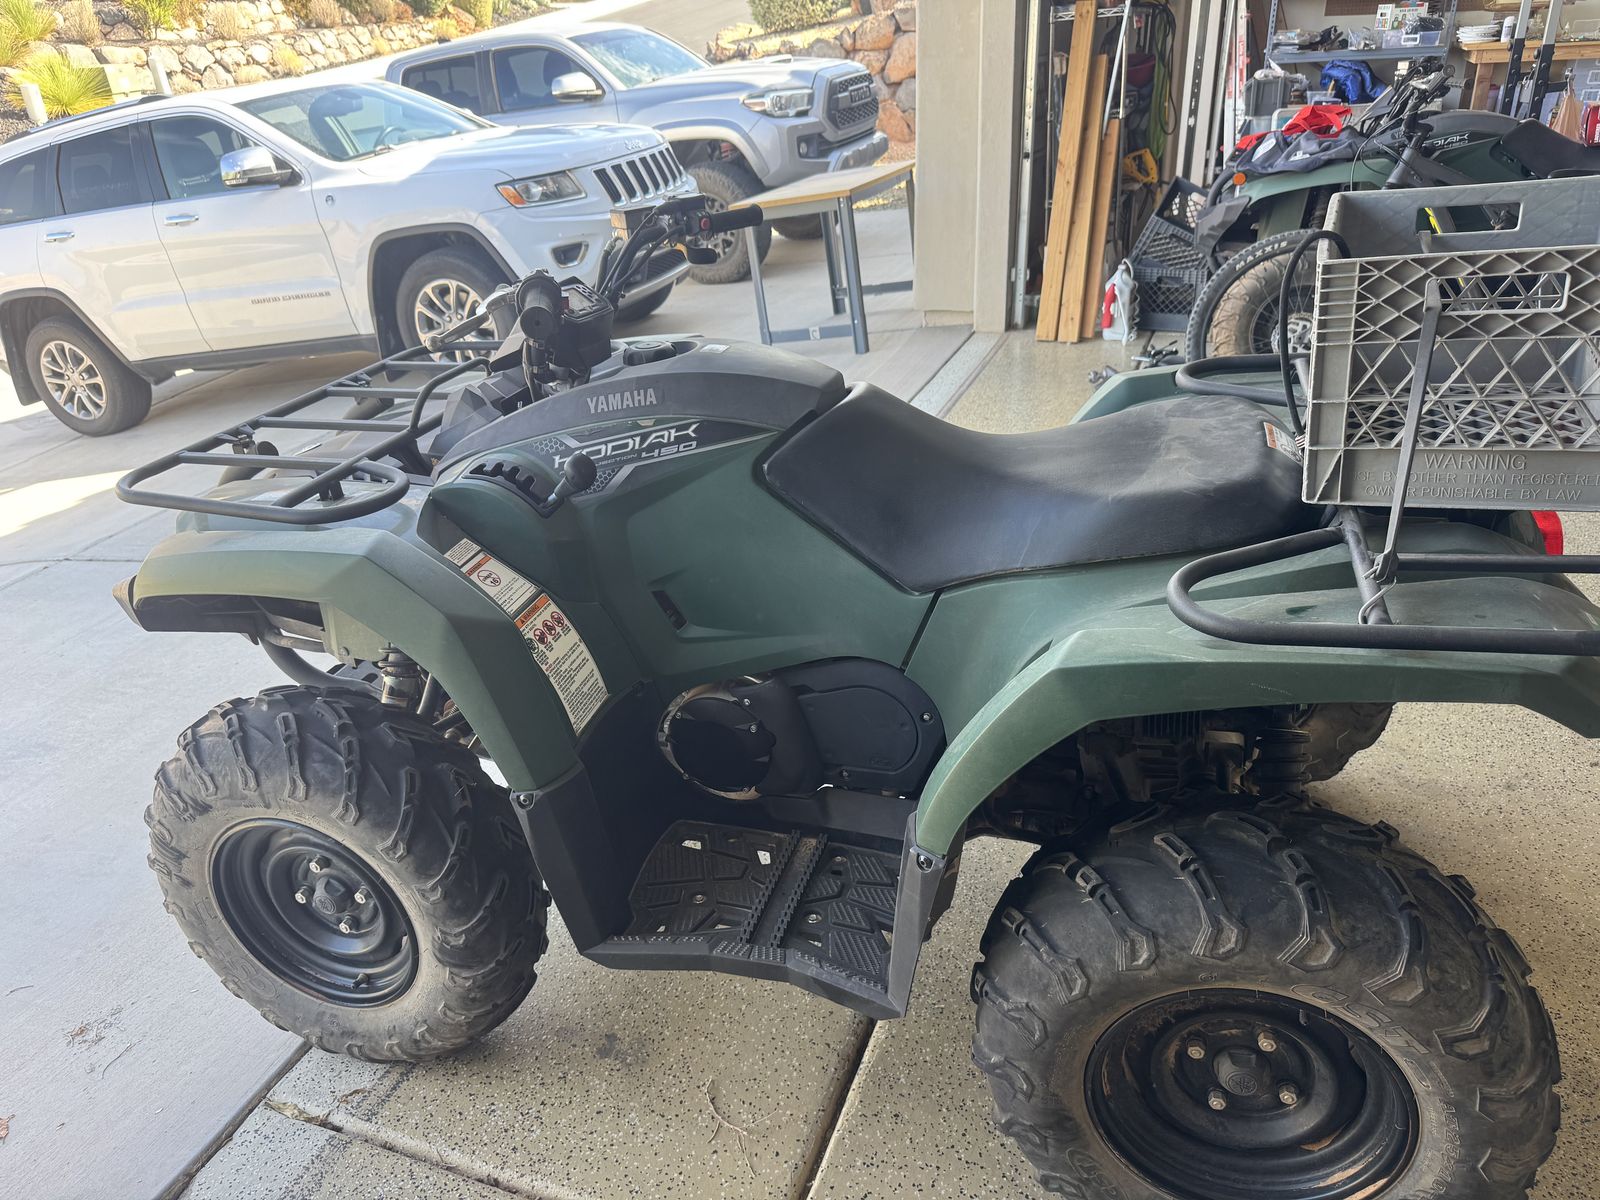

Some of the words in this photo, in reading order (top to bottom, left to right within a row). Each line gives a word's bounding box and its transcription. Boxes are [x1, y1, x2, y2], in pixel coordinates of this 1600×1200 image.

[1235, 241, 1288, 271] MAXXIS
[586, 388, 657, 414] YAMAHA
[641, 440, 697, 458] 450
[1424, 452, 1527, 470] WARNING
[1464, 473, 1505, 485] THAN
[1365, 485, 1416, 497] OWNR
[1421, 487, 1512, 499] PUNISHABLE
[1521, 488, 1540, 499] BY
[1546, 489, 1581, 500] LAW
